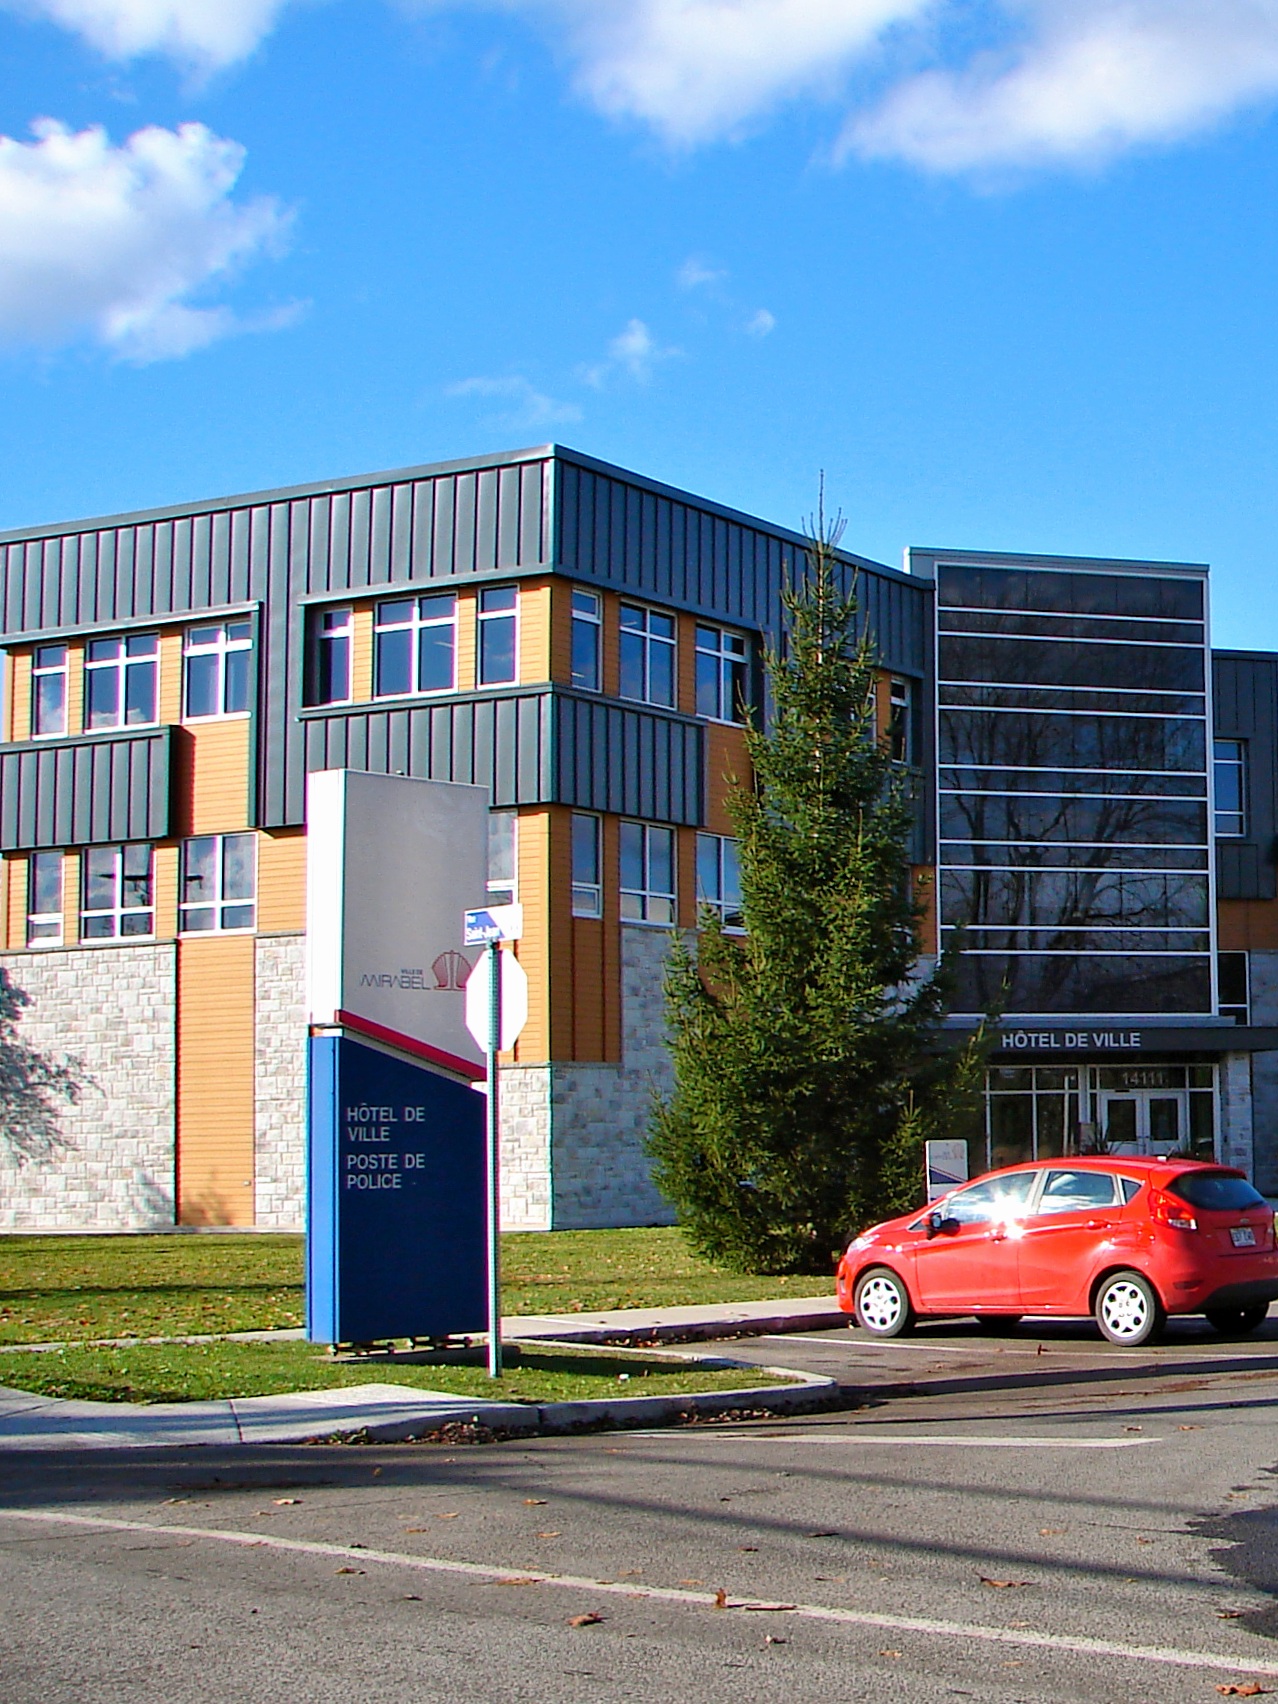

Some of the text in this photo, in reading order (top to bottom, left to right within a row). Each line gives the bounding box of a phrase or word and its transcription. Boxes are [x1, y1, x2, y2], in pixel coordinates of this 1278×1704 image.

[360, 973, 431, 991] MIRABEL
[1001, 1029, 1142, 1048] HÔTEL DE VILLE
[346, 1102, 426, 1122] HÔTEL DE
[347, 1126, 391, 1142] VILLE
[346, 1153, 426, 1170] POSTE DE
[346, 1173, 403, 1189] POLICE
